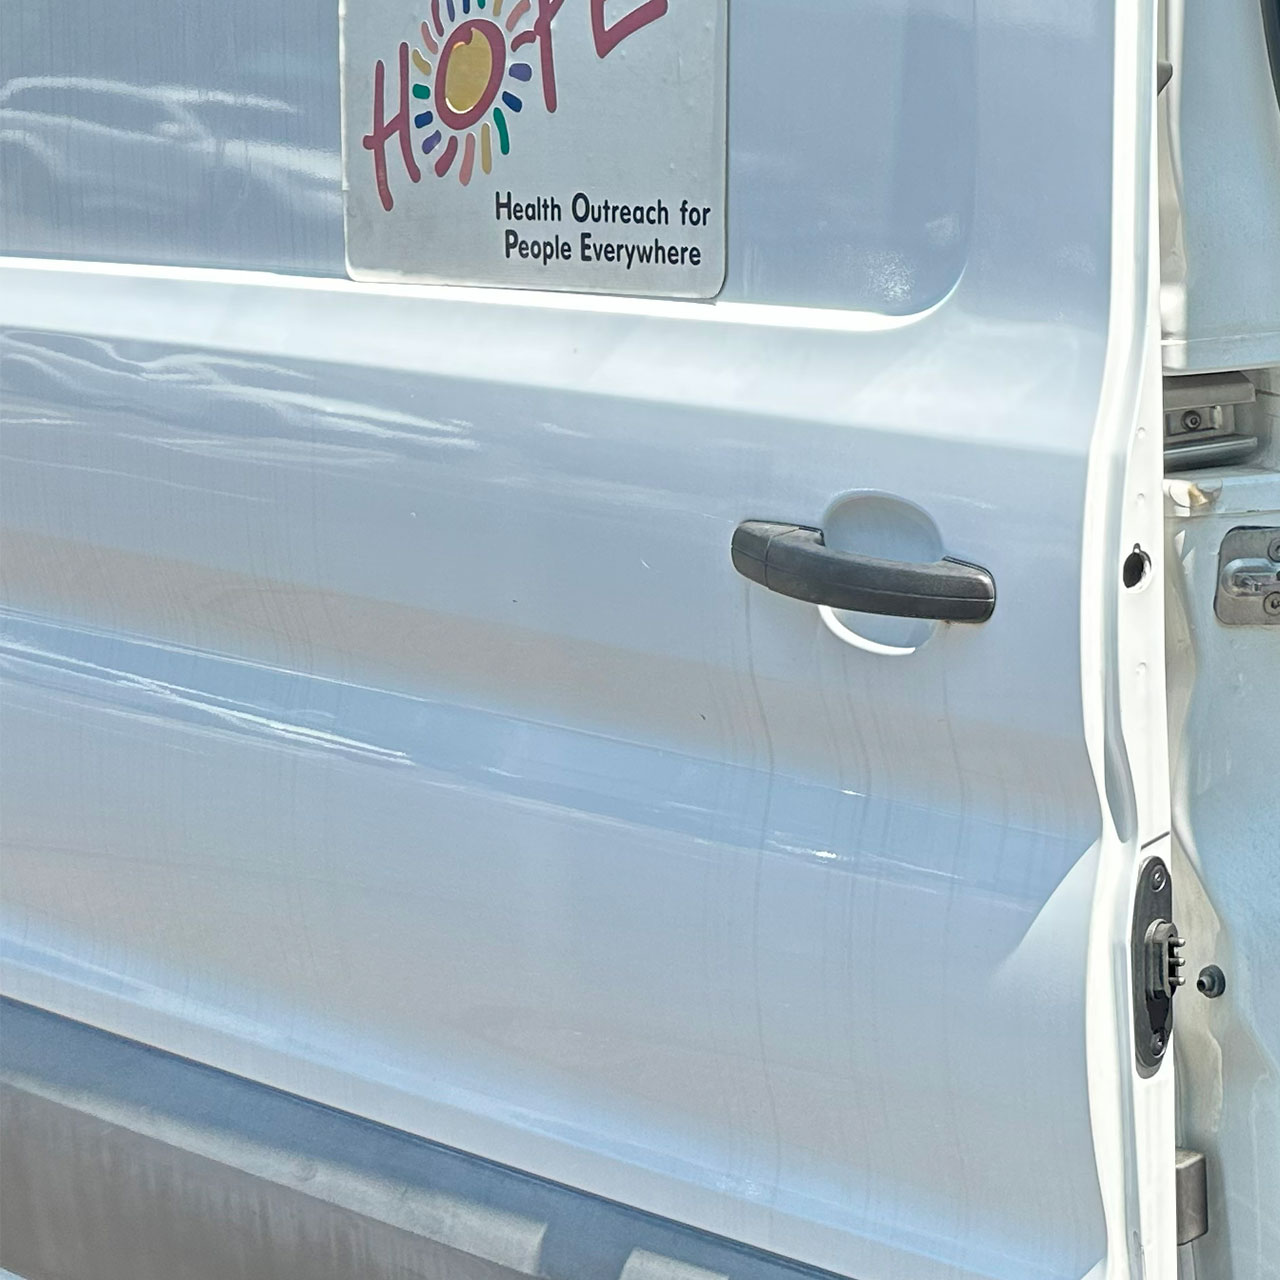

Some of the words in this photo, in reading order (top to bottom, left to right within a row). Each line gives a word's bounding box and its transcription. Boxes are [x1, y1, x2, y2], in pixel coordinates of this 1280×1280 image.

[495, 191, 562, 222] Health
[571, 192, 669, 226] Outreach
[679, 200, 711, 226] for
[504, 229, 572, 266] People
[580, 232, 702, 269] Everywhere
